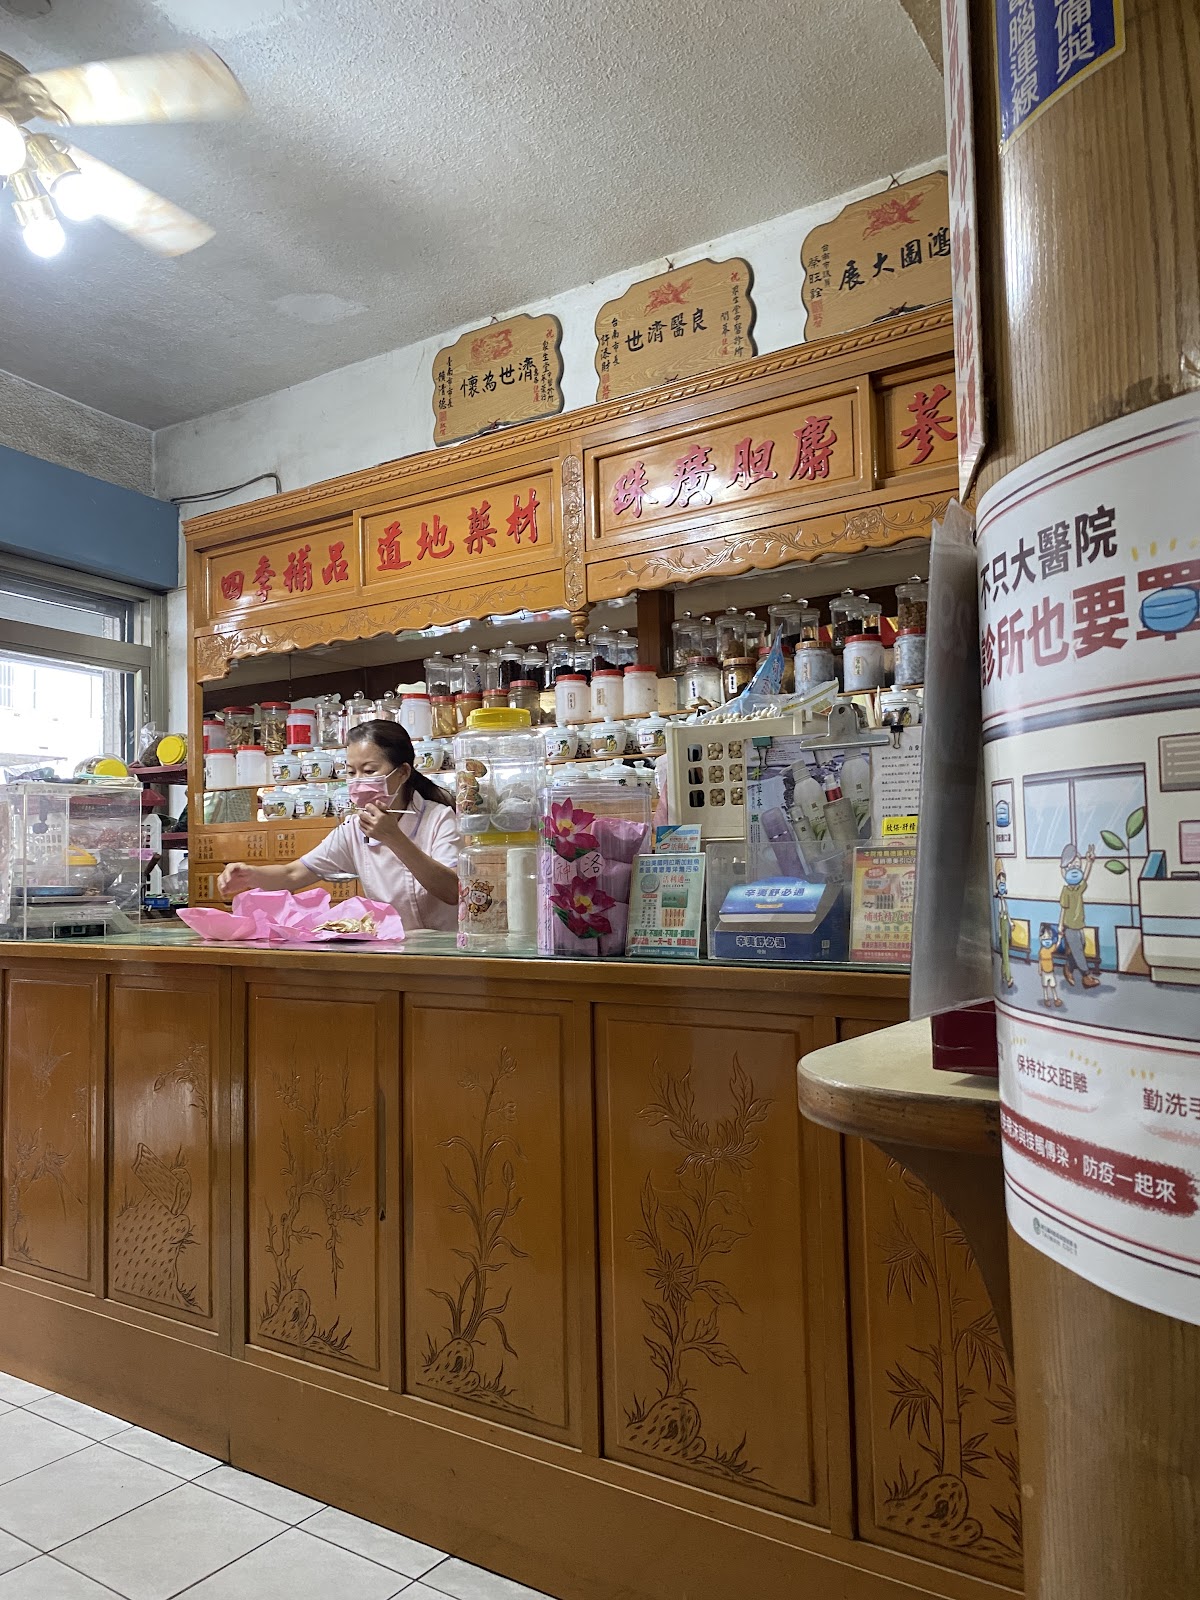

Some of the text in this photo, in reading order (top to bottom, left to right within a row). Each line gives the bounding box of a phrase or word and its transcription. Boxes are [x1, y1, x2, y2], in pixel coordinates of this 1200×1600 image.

[1055, 0, 1095, 83] 備與
[600, 333, 612, 373] 許添財
[625, 307, 708, 353] 良醫濟世
[376, 487, 541, 573] 道地藥材
[980, 504, 1118, 611] 不只大醫院
[220, 541, 349, 603] 四季補品
[1016, 1053, 1089, 1094] 保持社交距離
